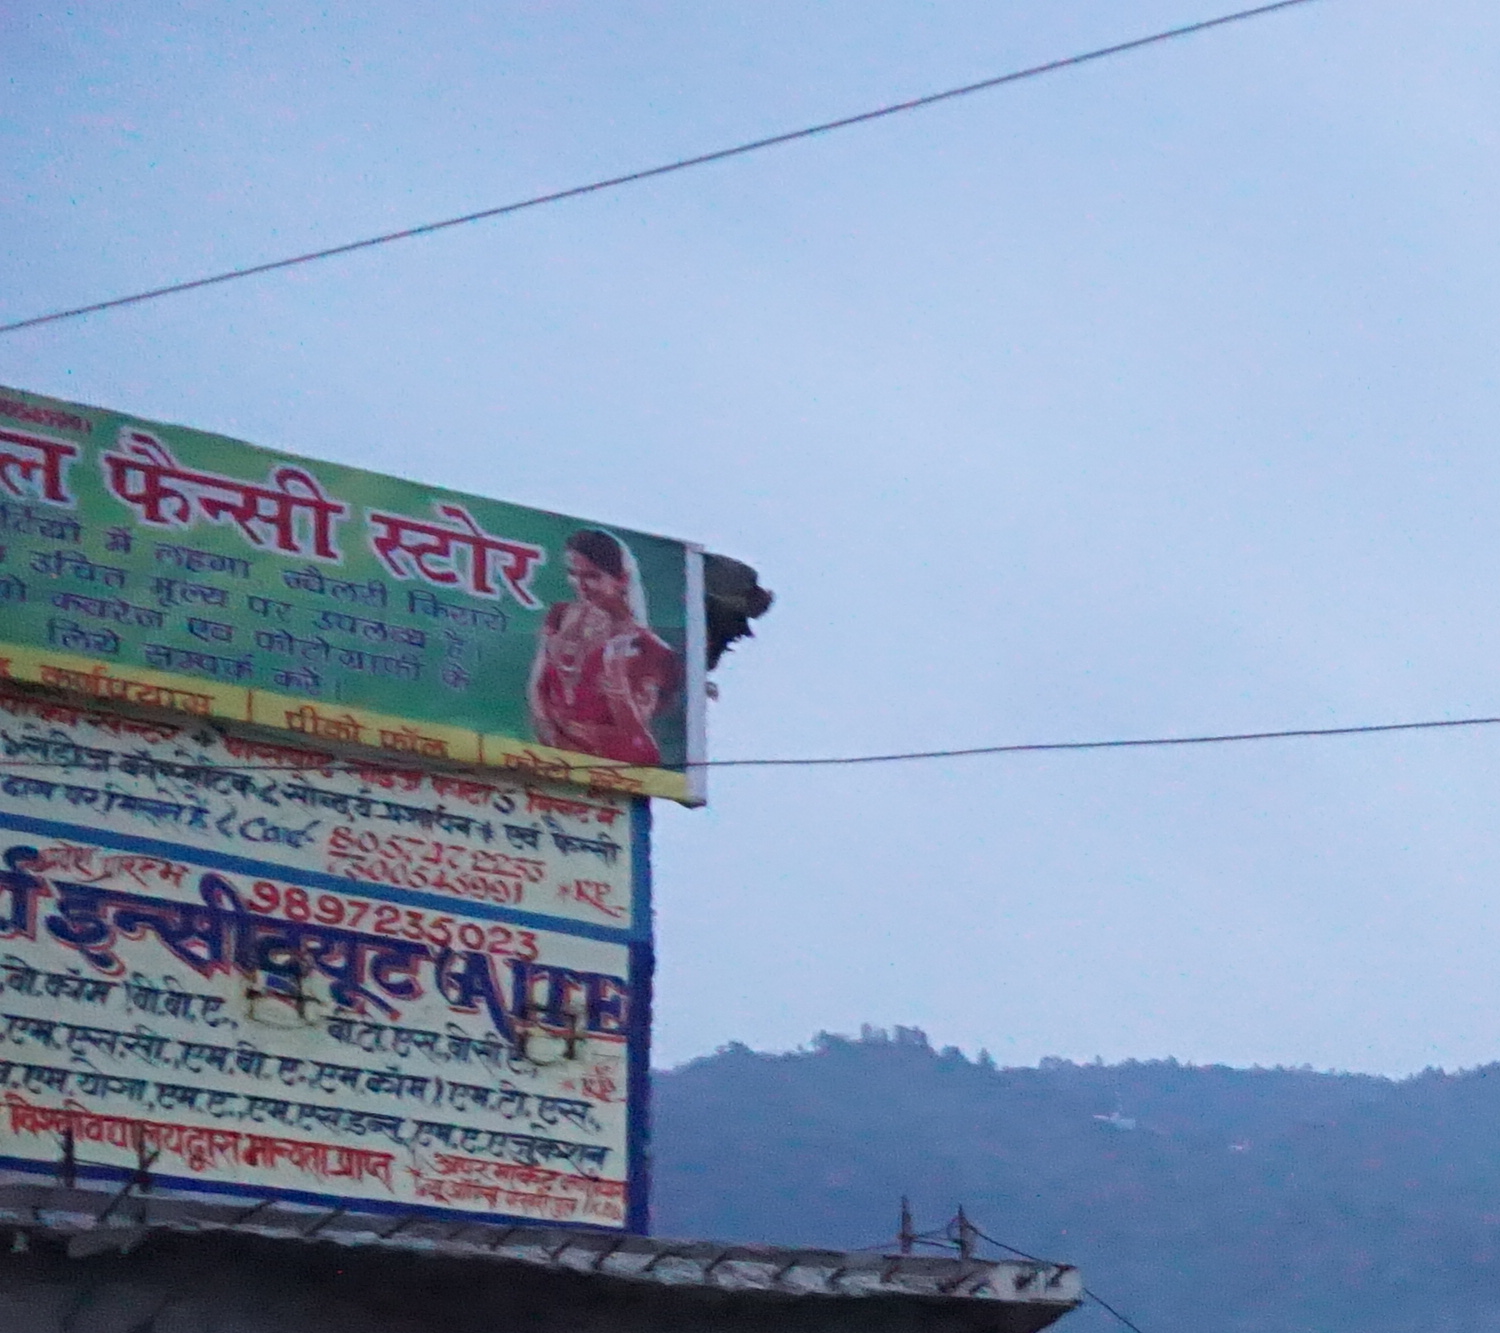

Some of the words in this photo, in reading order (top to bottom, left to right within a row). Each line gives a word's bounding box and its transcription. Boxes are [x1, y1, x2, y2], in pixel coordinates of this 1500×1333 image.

[104, 430, 343, 558] फैन्सी
[370, 503, 542, 606] स्टोर
[248, 880, 541, 962] 9897235023
